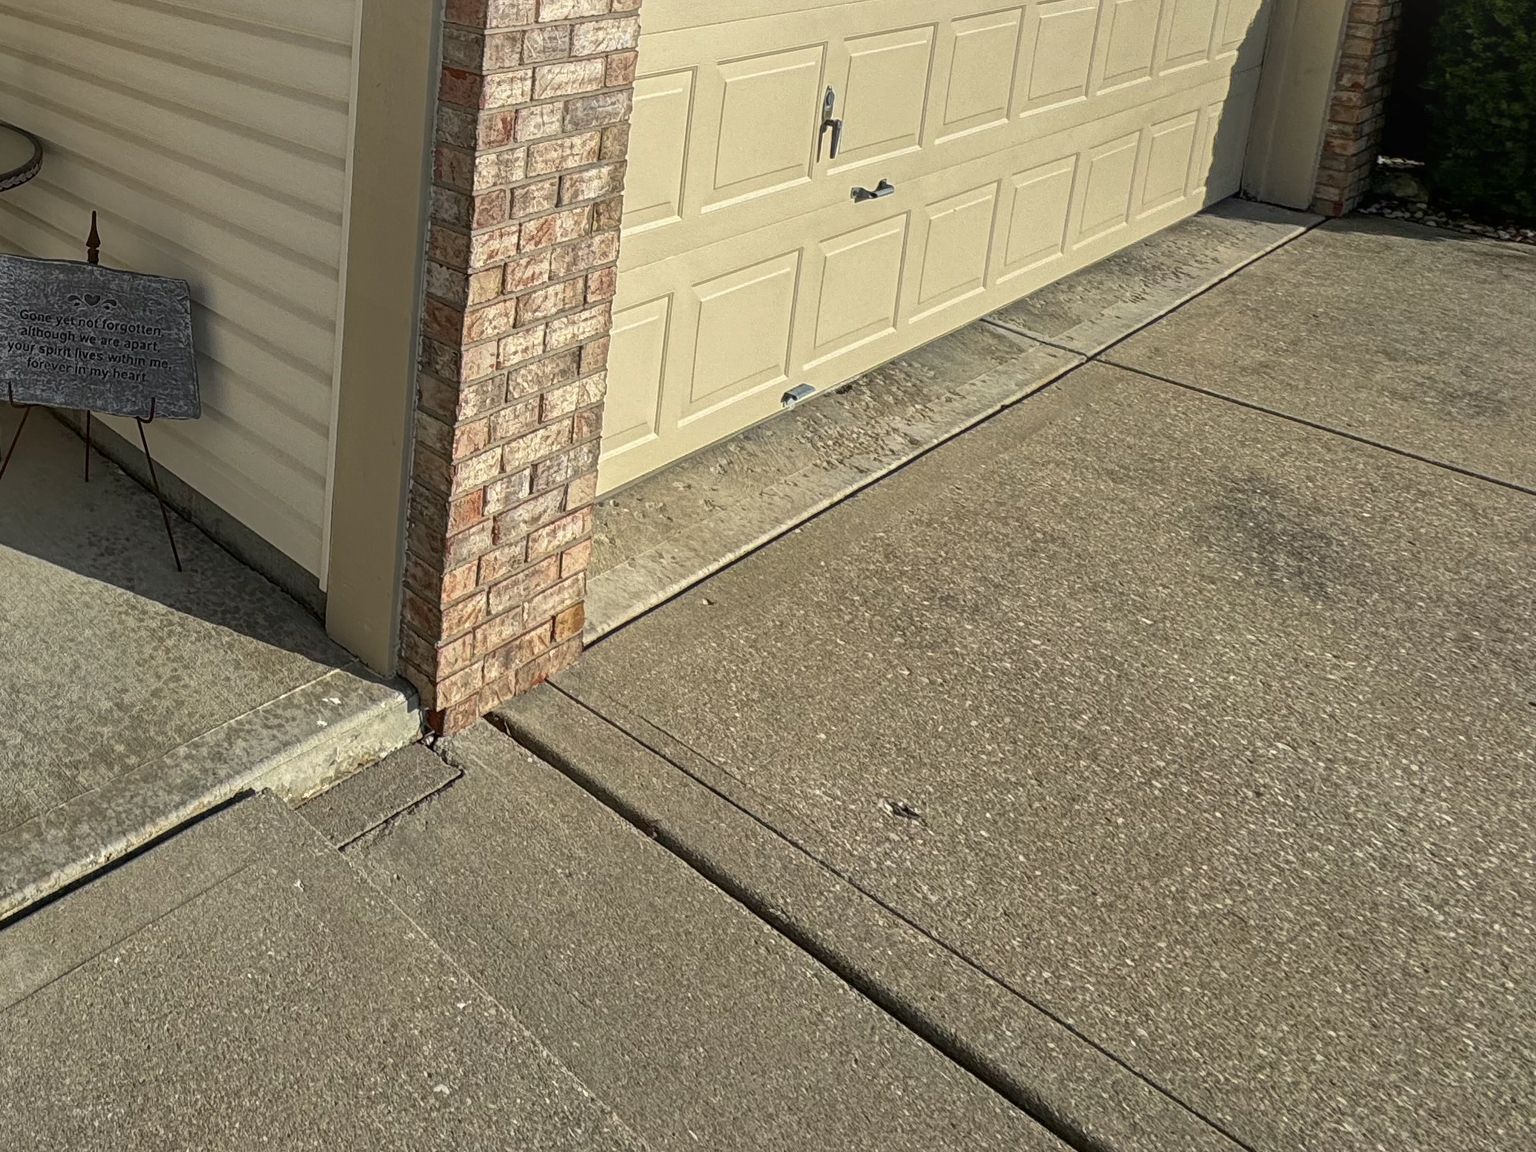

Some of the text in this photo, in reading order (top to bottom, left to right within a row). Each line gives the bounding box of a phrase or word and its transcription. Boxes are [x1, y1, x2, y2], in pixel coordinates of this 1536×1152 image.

[19, 309, 164, 338] Gone yet not forgotten,
[20, 326, 75, 343] although
[79, 334, 97, 345] we
[100, 336, 120, 348] are
[7, 340, 173, 372] your spirit lives within me,
[26, 357, 72, 374] forever
[75, 364, 86, 376] in
[89, 367, 109, 380] my
